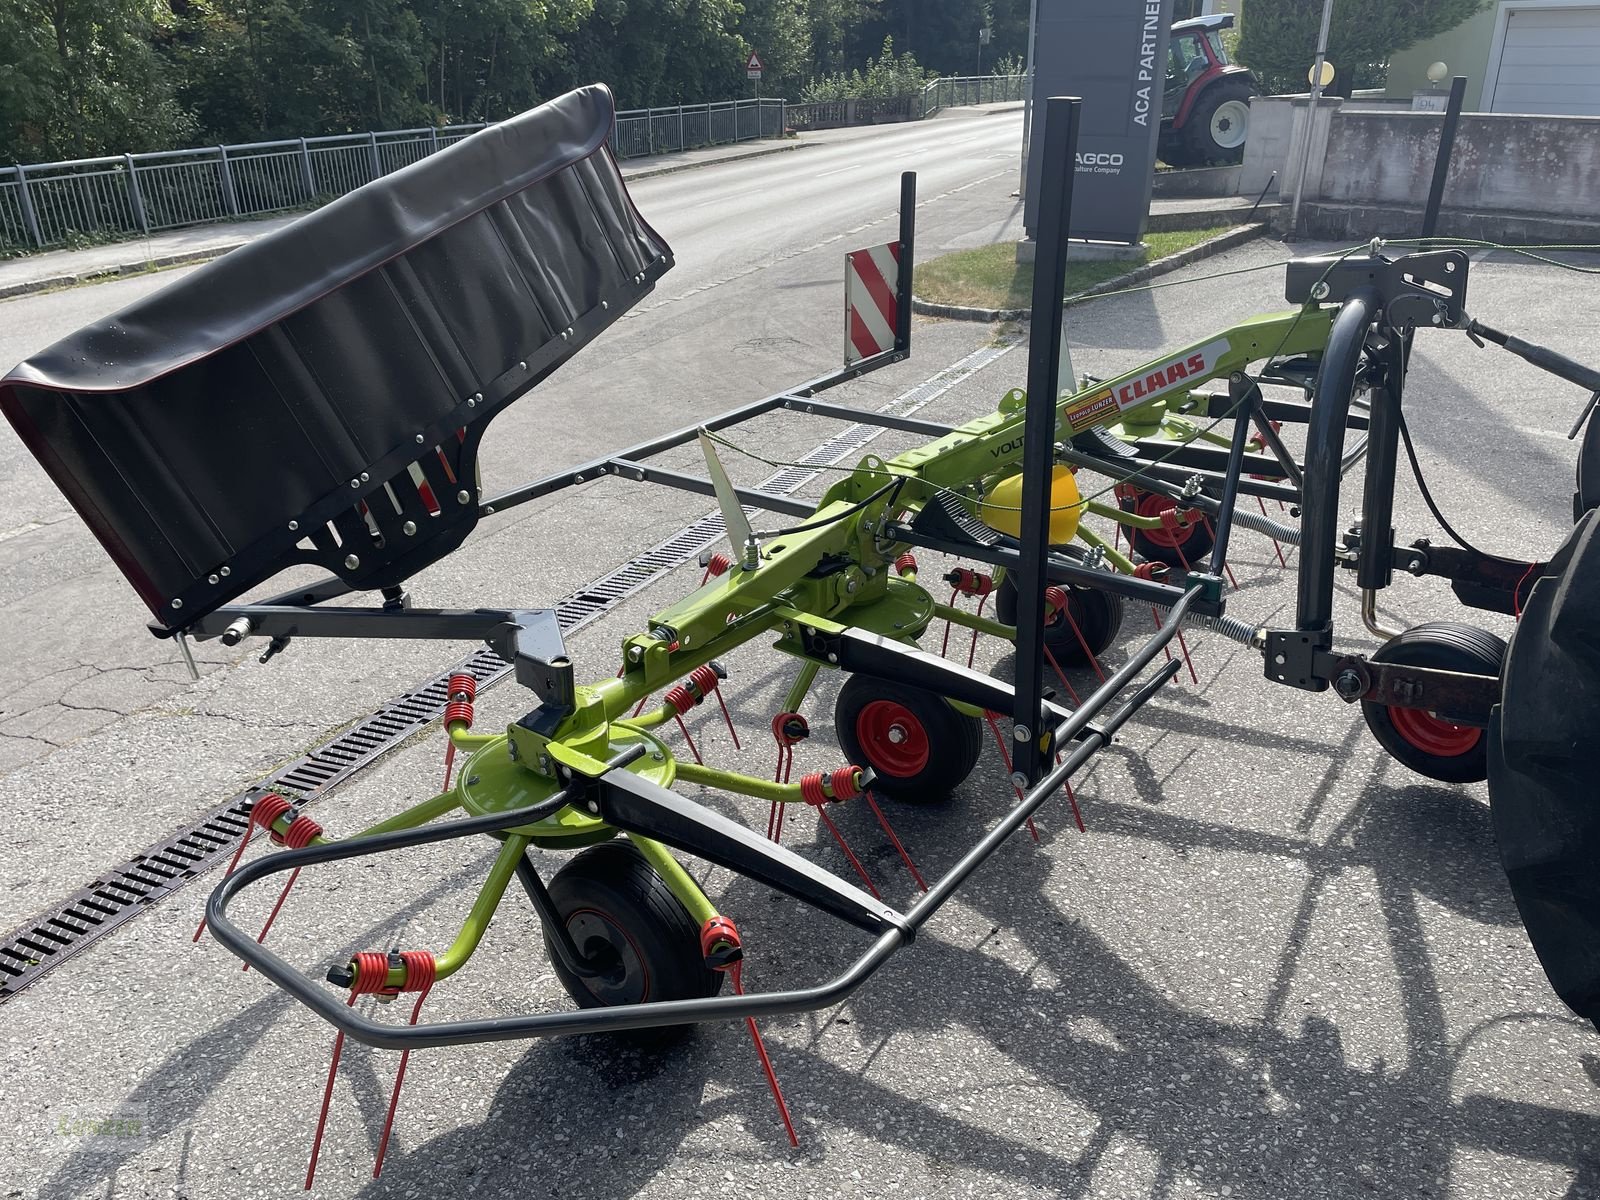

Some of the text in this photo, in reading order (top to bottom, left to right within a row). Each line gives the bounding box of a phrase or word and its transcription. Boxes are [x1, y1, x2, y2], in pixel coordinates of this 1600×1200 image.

[1133, 0, 1160, 126] ACA PARTNE
[1075, 152, 1124, 166] AGCO
[1093, 166, 1121, 175] Company
[1118, 353, 1206, 405] CLAAS
[1091, 397, 1114, 411] LUNZER
[990, 435, 1025, 458] VOLT
